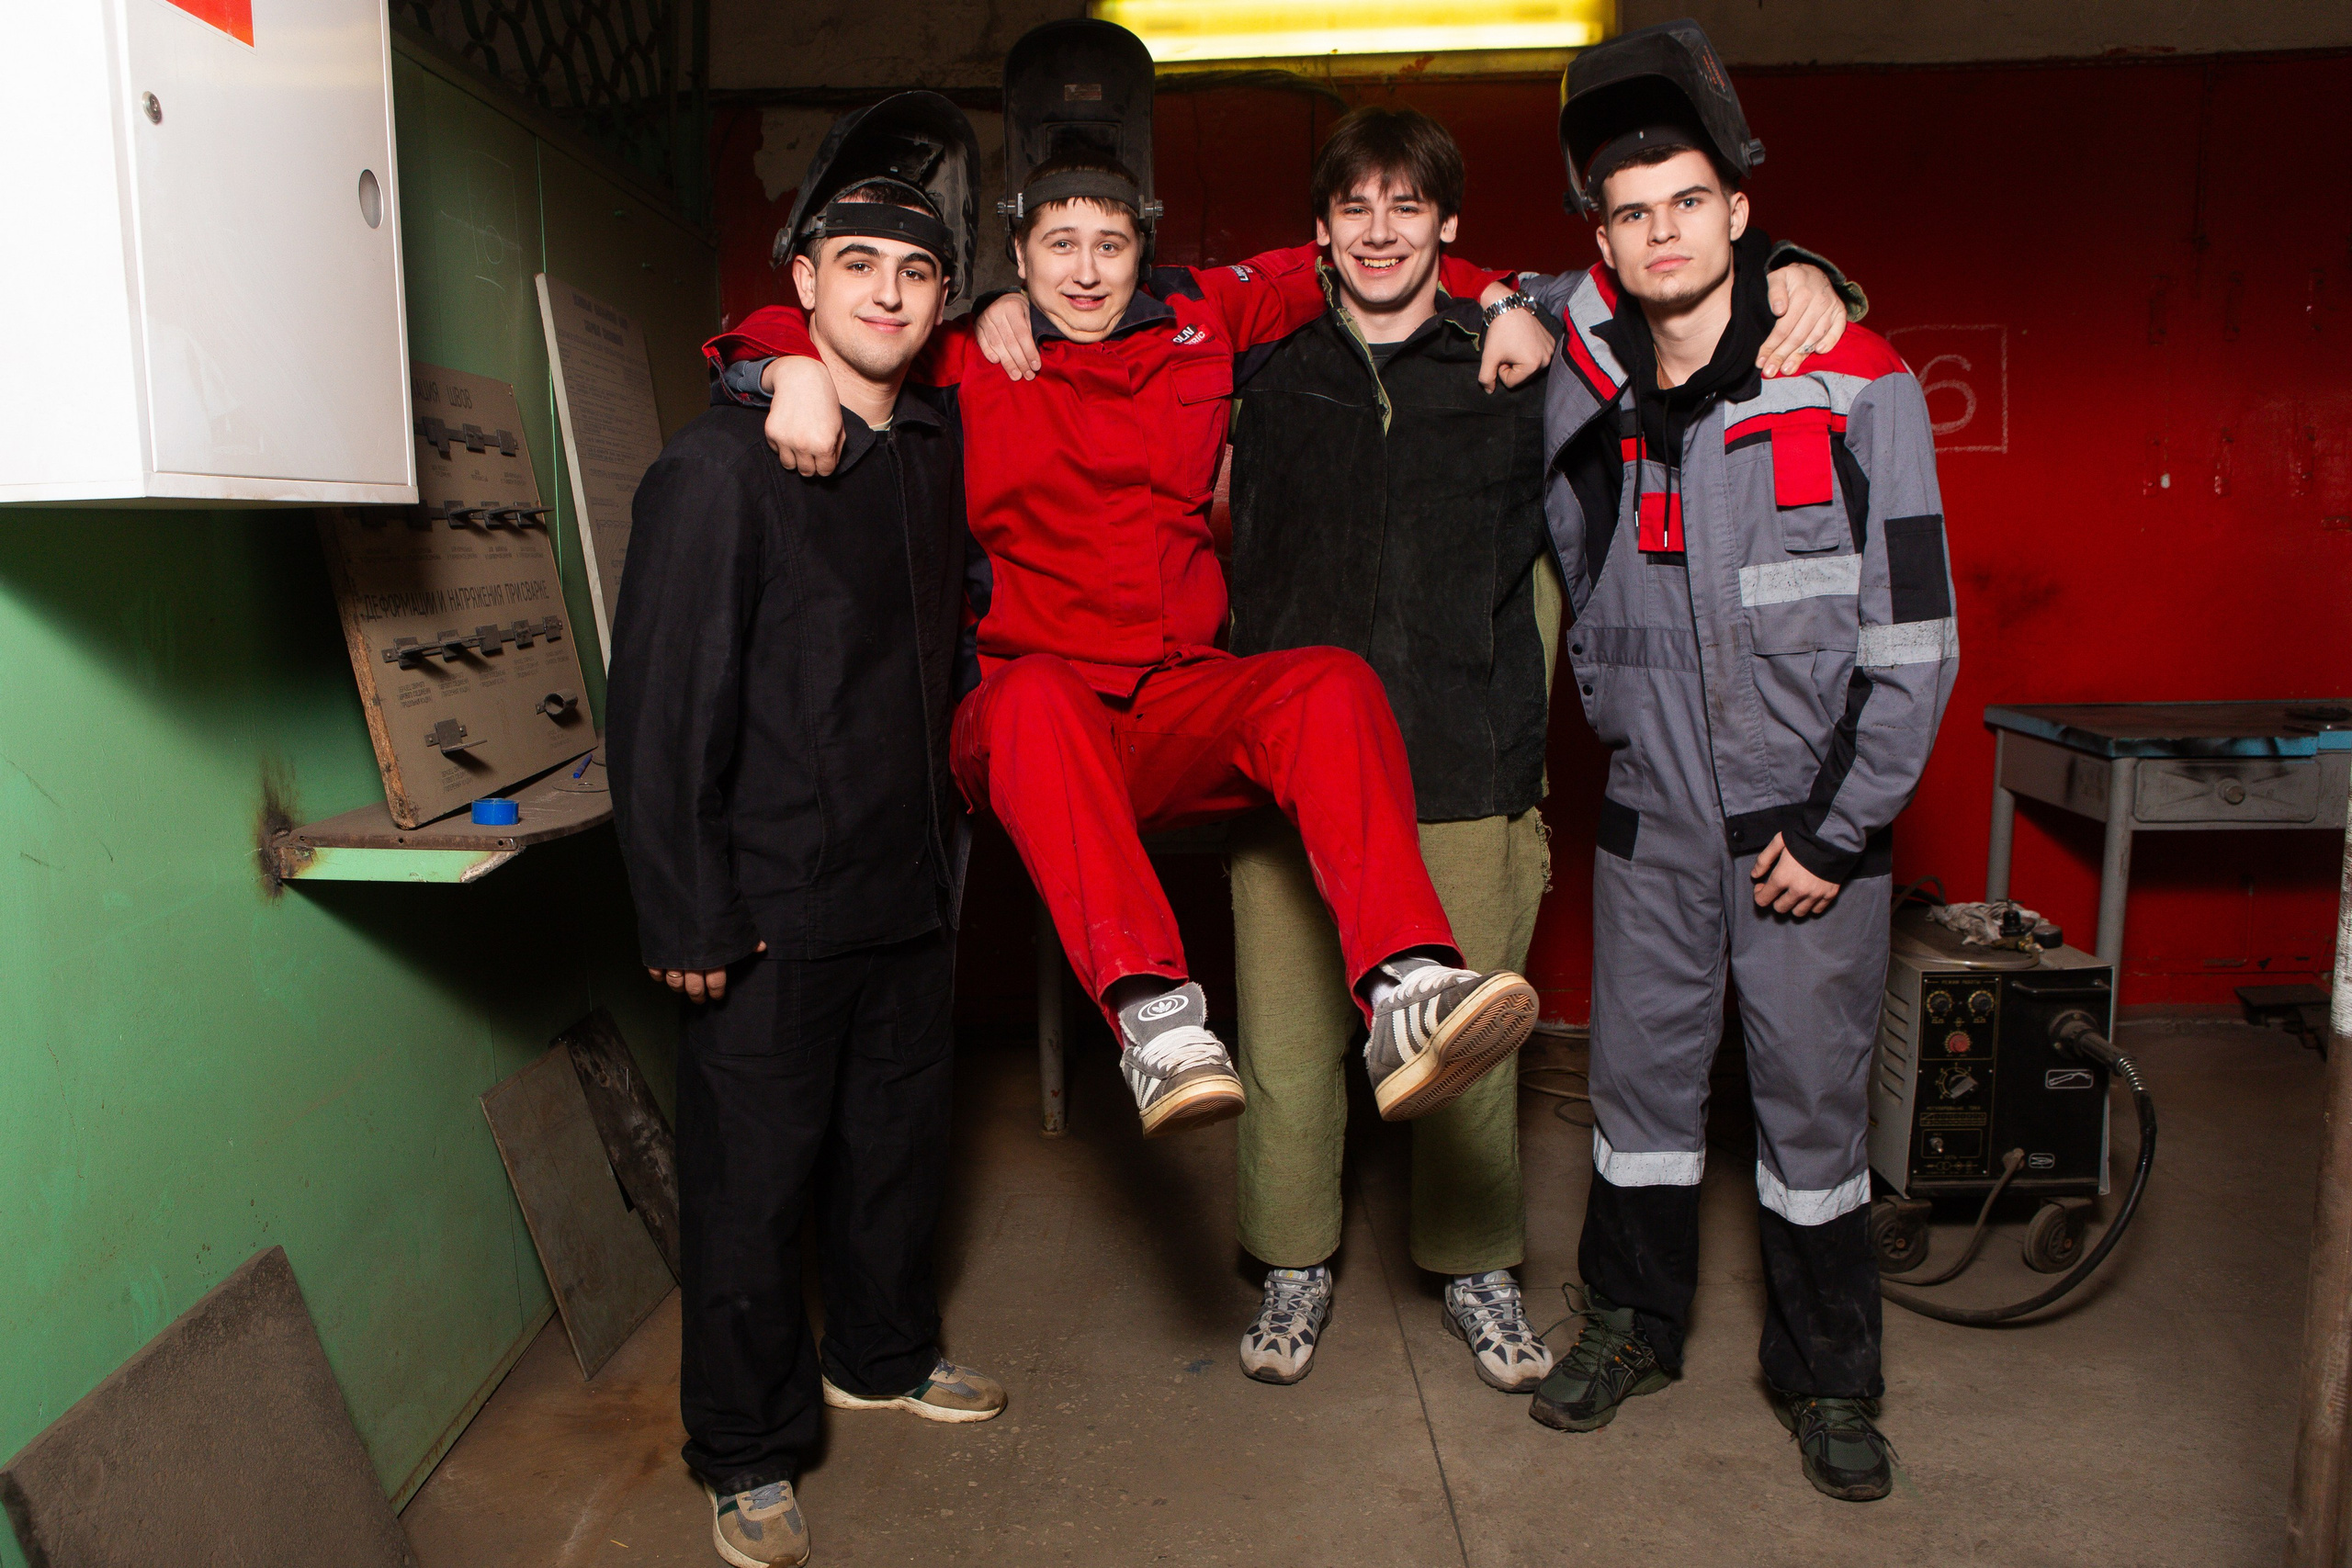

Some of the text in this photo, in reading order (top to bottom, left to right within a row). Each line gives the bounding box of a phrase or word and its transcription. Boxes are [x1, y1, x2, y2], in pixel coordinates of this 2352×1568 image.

[447, 384, 472, 410] ШВОВ
[364, 591, 438, 623] ДЕФОРМАЦИИ
[436, 589, 447, 614] И
[447, 583, 505, 612] НАПРЯЖЕНИЯ
